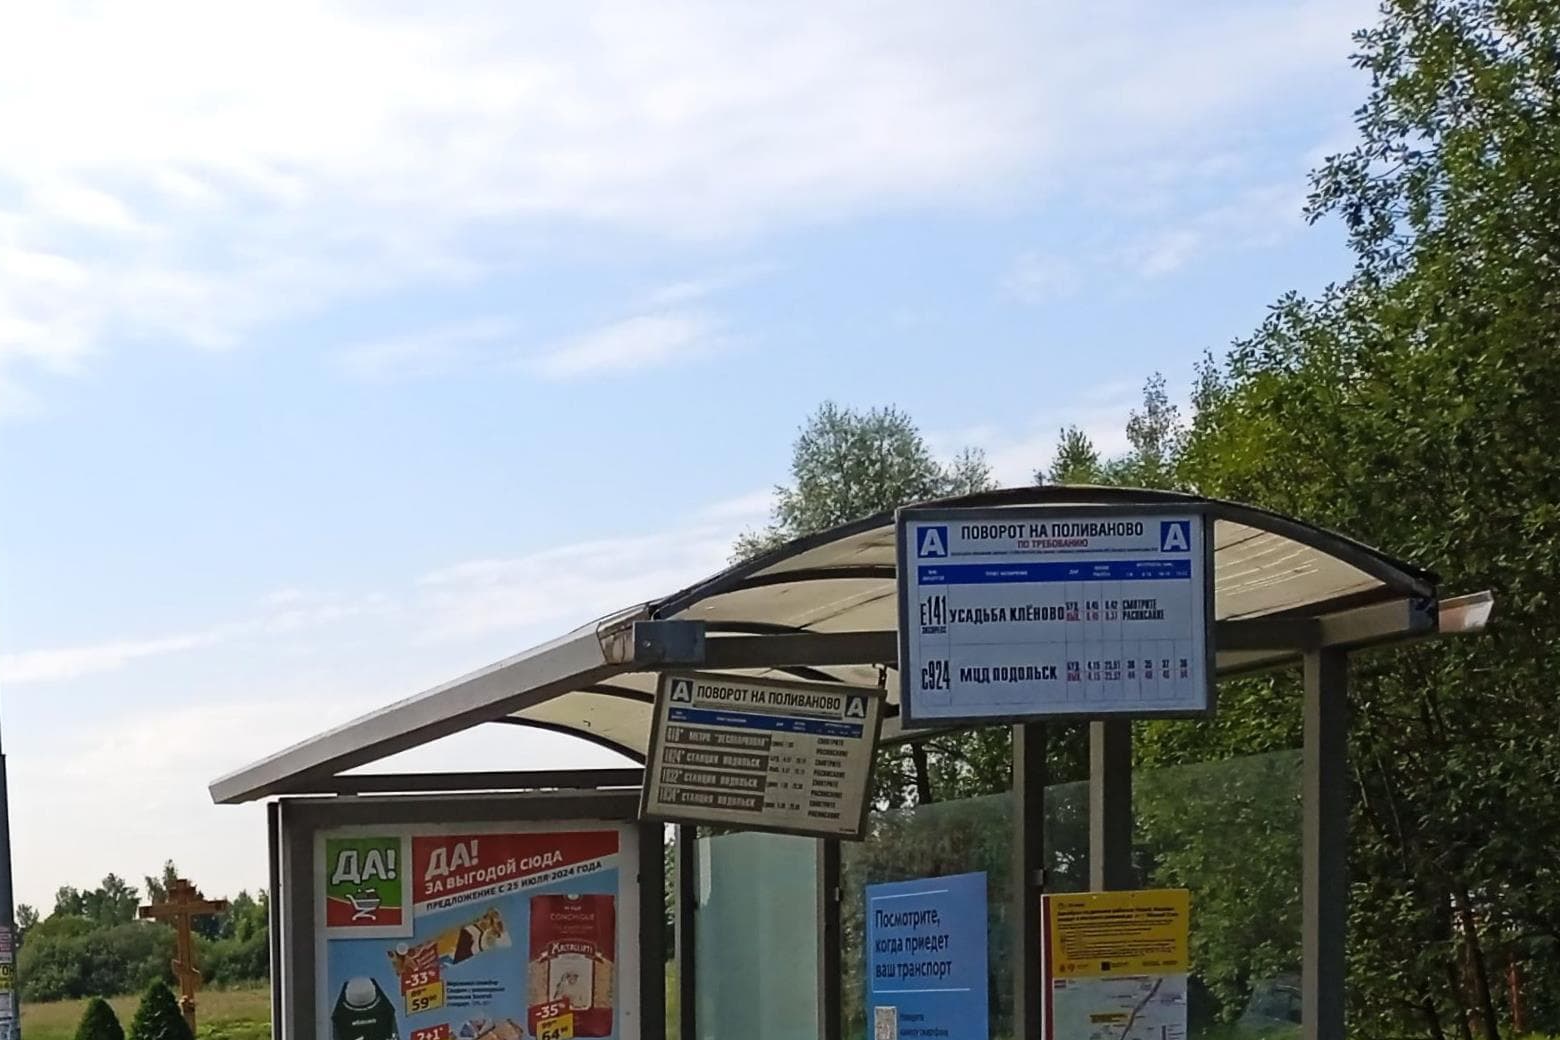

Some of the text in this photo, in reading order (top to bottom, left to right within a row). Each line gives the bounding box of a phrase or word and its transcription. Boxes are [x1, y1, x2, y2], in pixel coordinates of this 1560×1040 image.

[961, 525, 1026, 540] ПОВОРОТ
[1029, 523, 1048, 538] НА
[1052, 522, 1144, 538] ПОЛИВАНОВО
[1017, 538, 1089, 549] ПО ТРЕБОВАНИЮ
[949, 608, 1007, 624] УСАДЬБА
[1010, 604, 1065, 621] КЛЁНОВО
[960, 667, 991, 683] МЦД
[992, 666, 1058, 682] ПОДОЛЬСК
[697, 685, 748, 701] ПОВОРОТ
[751, 691, 765, 704] НА
[768, 692, 841, 710] ПОЛИВАНОВО
[331, 849, 397, 885] ДА!
[425, 839, 478, 881] ДА!
[424, 850, 563, 895] ЗА ВЫГОДОЙ СЮДА
[426, 861, 602, 911] ПРЕДЛОЖЕНИЕ С 25 ИЮЛЯ 2024 ГОДА
[875, 909, 941, 931] Посмотрите,
[875, 934, 950, 955] когда приедет
[876, 961, 952, 980] ваш транспорт
